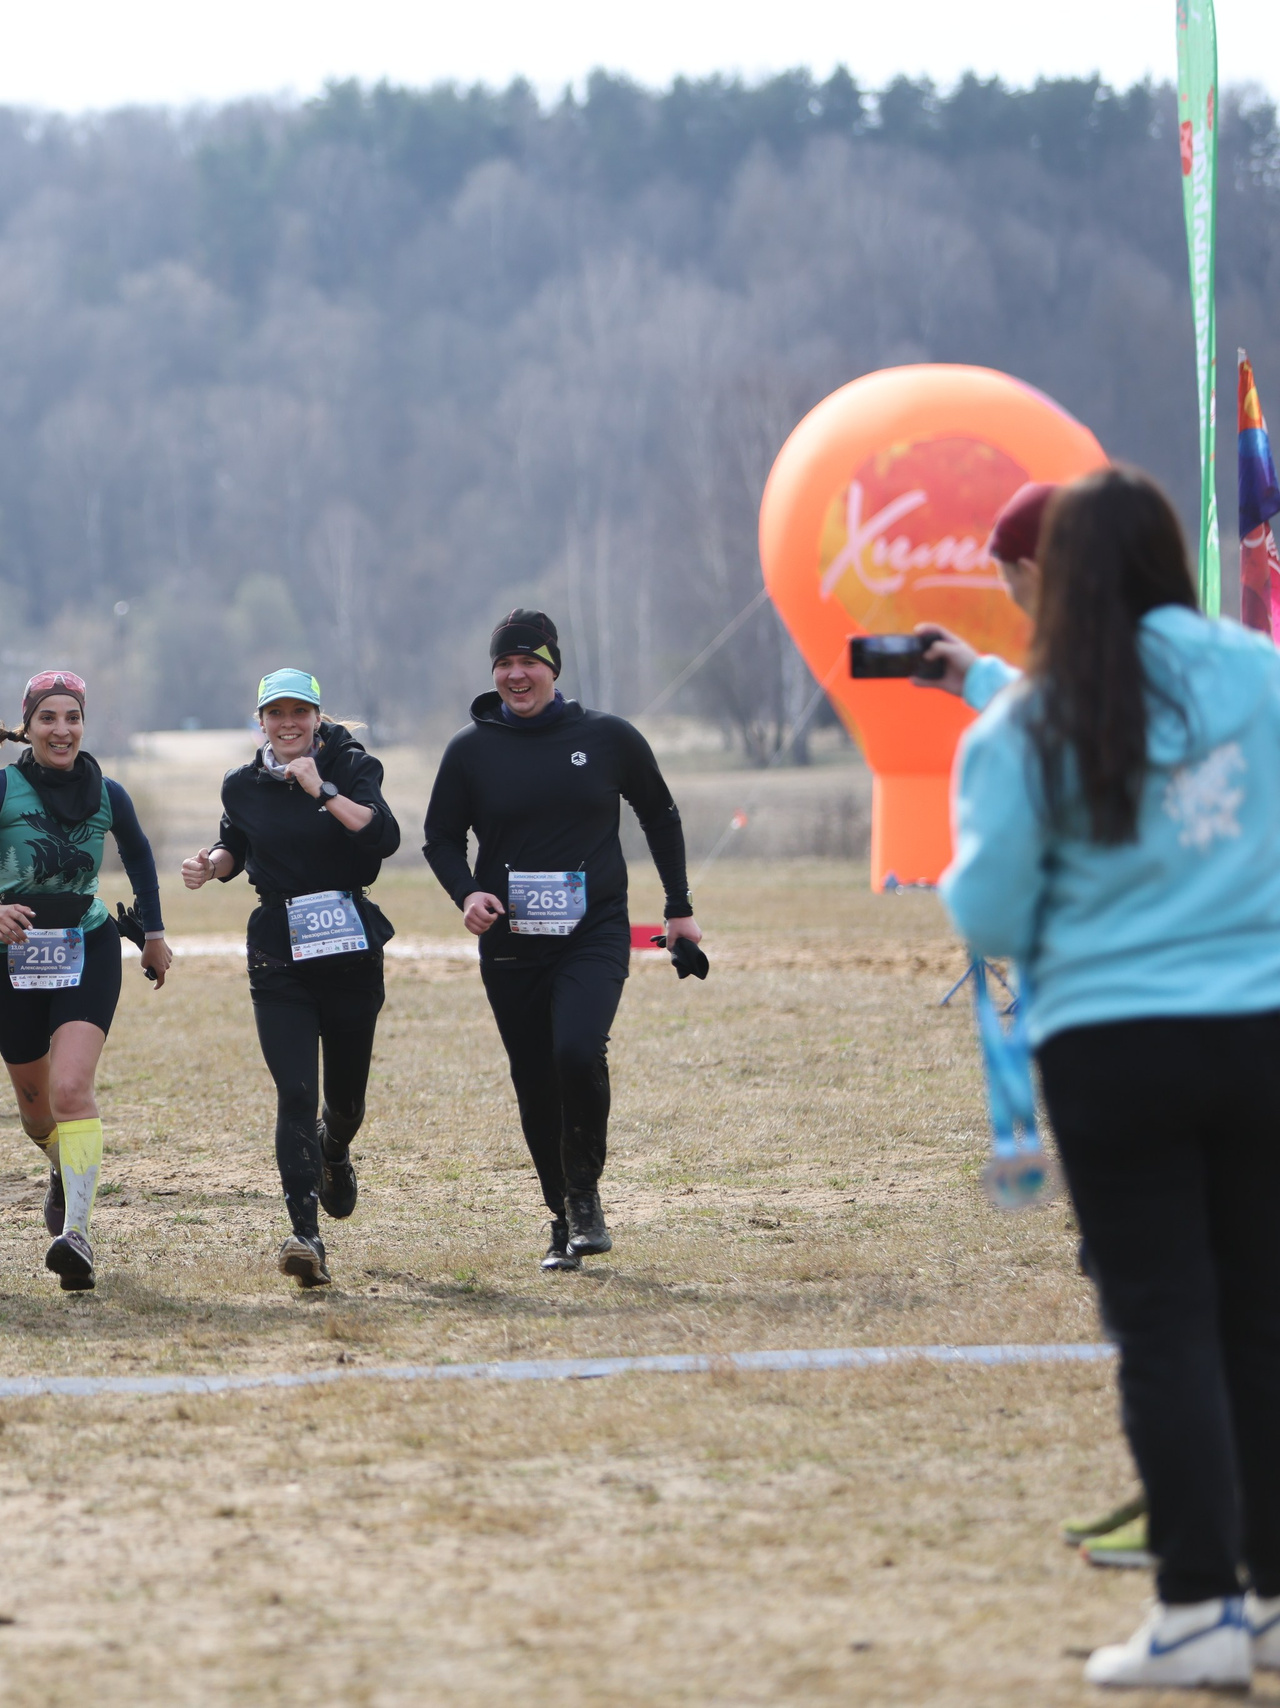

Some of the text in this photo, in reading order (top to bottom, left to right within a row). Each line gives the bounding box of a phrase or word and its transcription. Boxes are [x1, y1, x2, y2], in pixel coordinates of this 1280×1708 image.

[527, 890, 566, 908] 263
[306, 908, 345, 930] 309
[26, 946, 65, 963] 216
